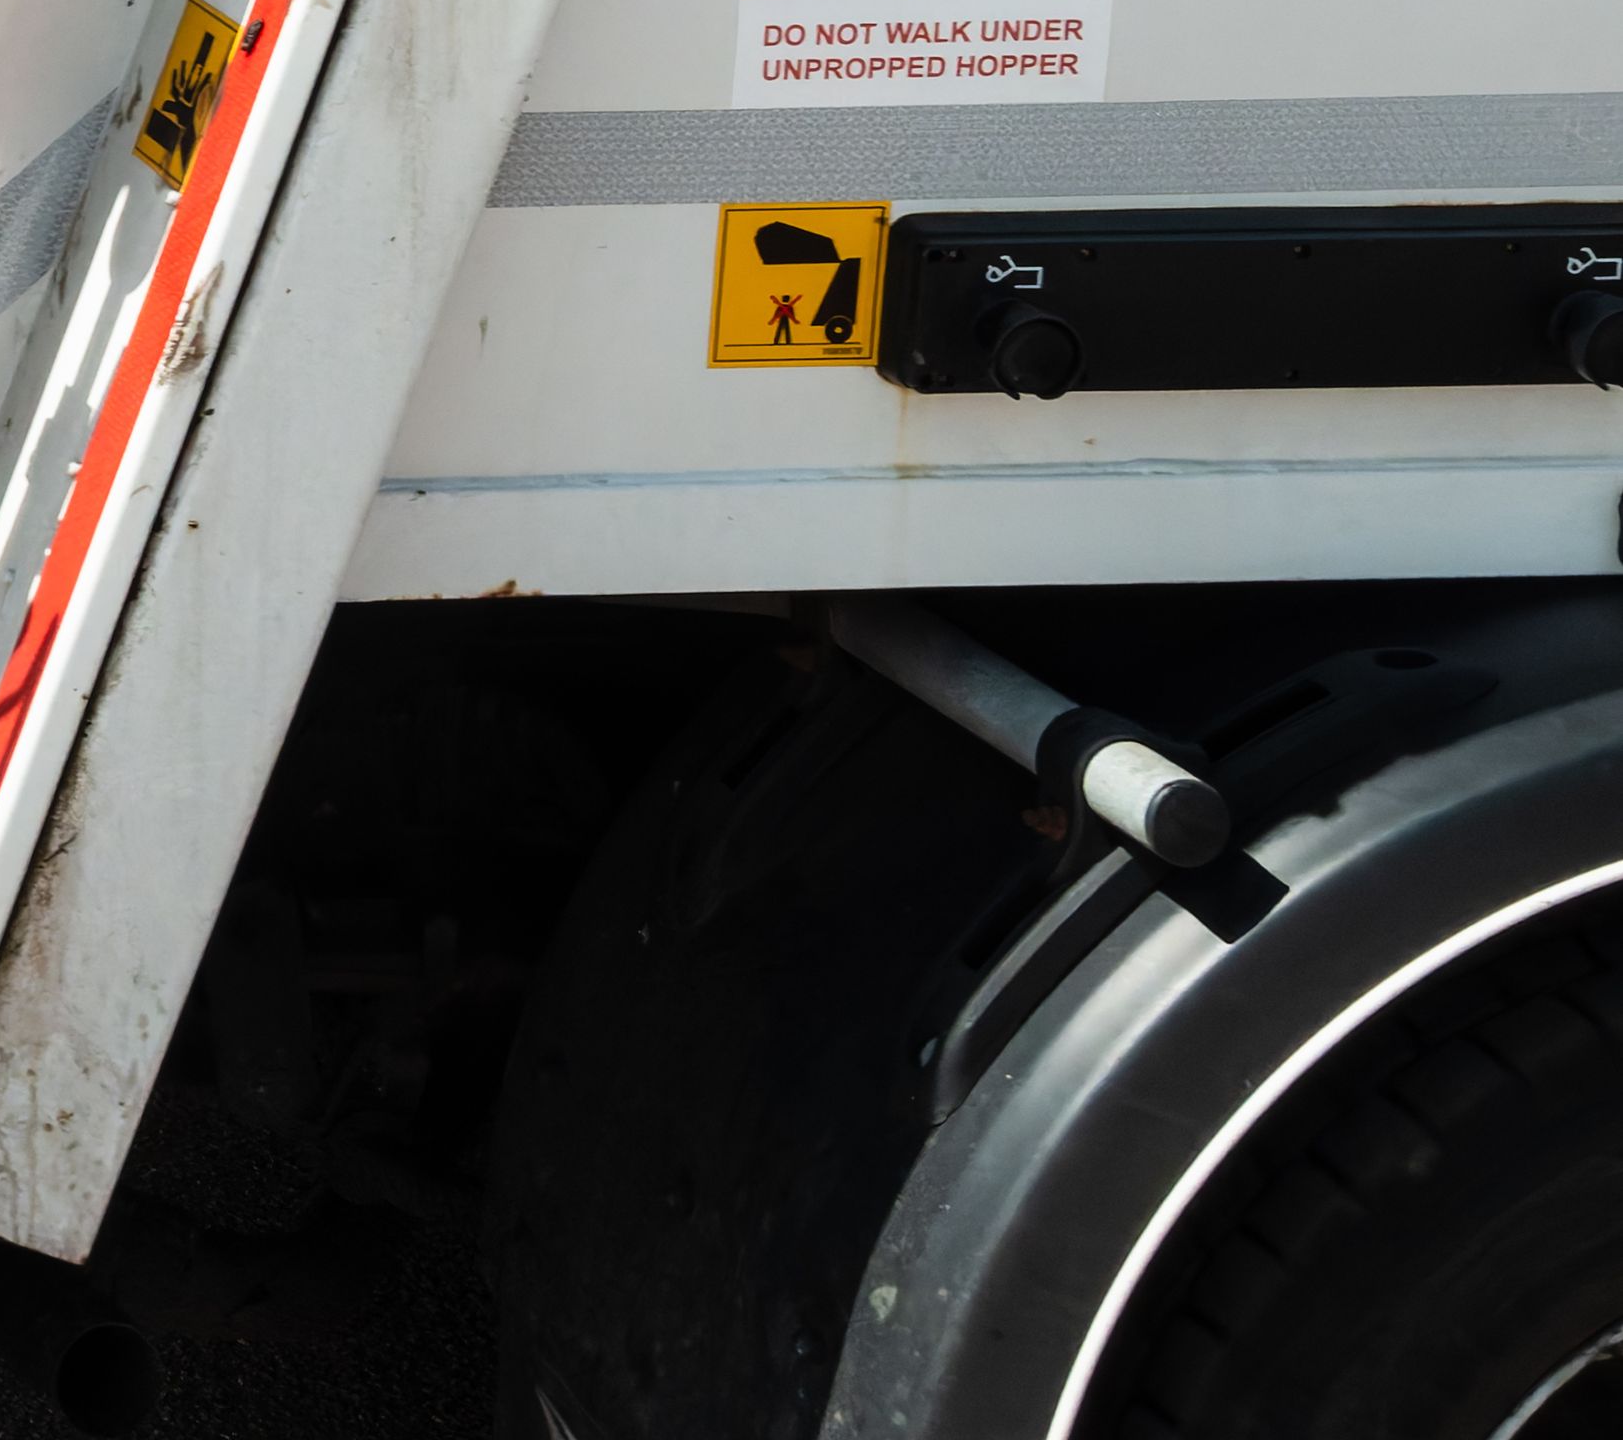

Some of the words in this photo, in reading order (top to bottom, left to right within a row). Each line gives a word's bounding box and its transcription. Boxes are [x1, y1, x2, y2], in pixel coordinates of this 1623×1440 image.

[763, 23, 806, 47] DO
[815, 22, 877, 46] NOT
[885, 21, 971, 44] WALK
[980, 18, 1084, 43] UNDER
[762, 54, 945, 81] UNPROPPED
[957, 52, 1079, 78] HOPPER
